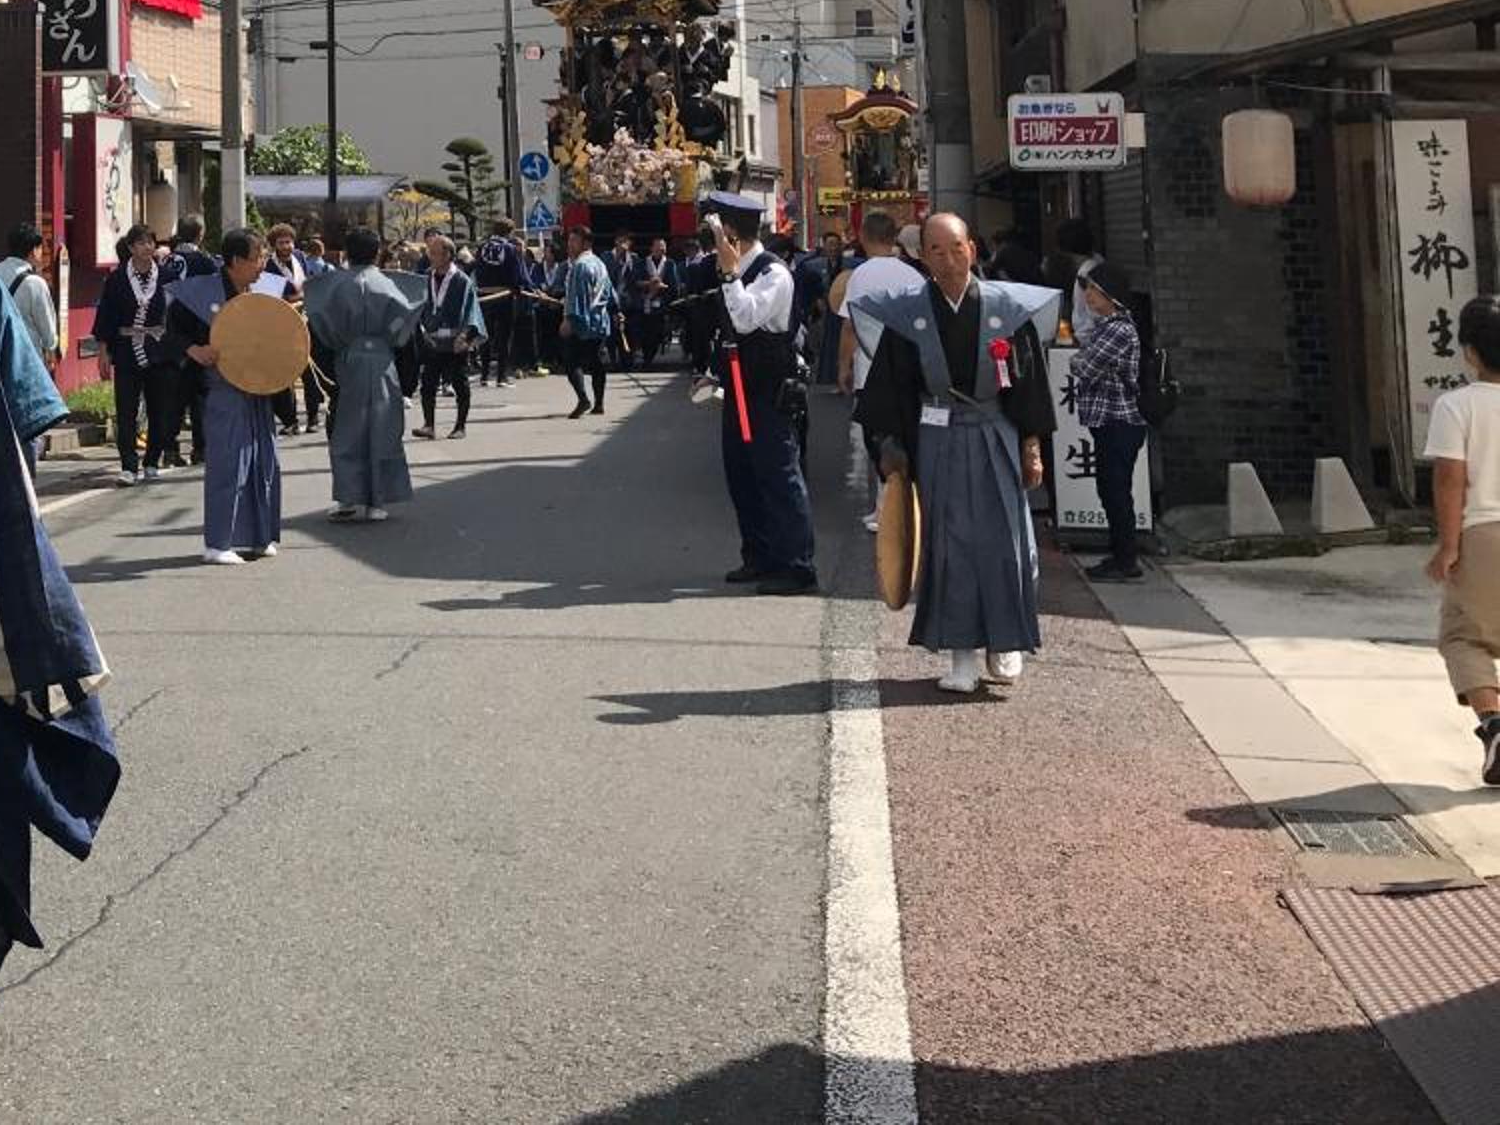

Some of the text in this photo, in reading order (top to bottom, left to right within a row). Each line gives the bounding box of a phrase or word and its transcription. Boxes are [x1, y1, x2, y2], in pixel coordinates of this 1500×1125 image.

[1020, 120, 1115, 143] 印刷ショップ
[1408, 231, 1470, 358] 柳生
